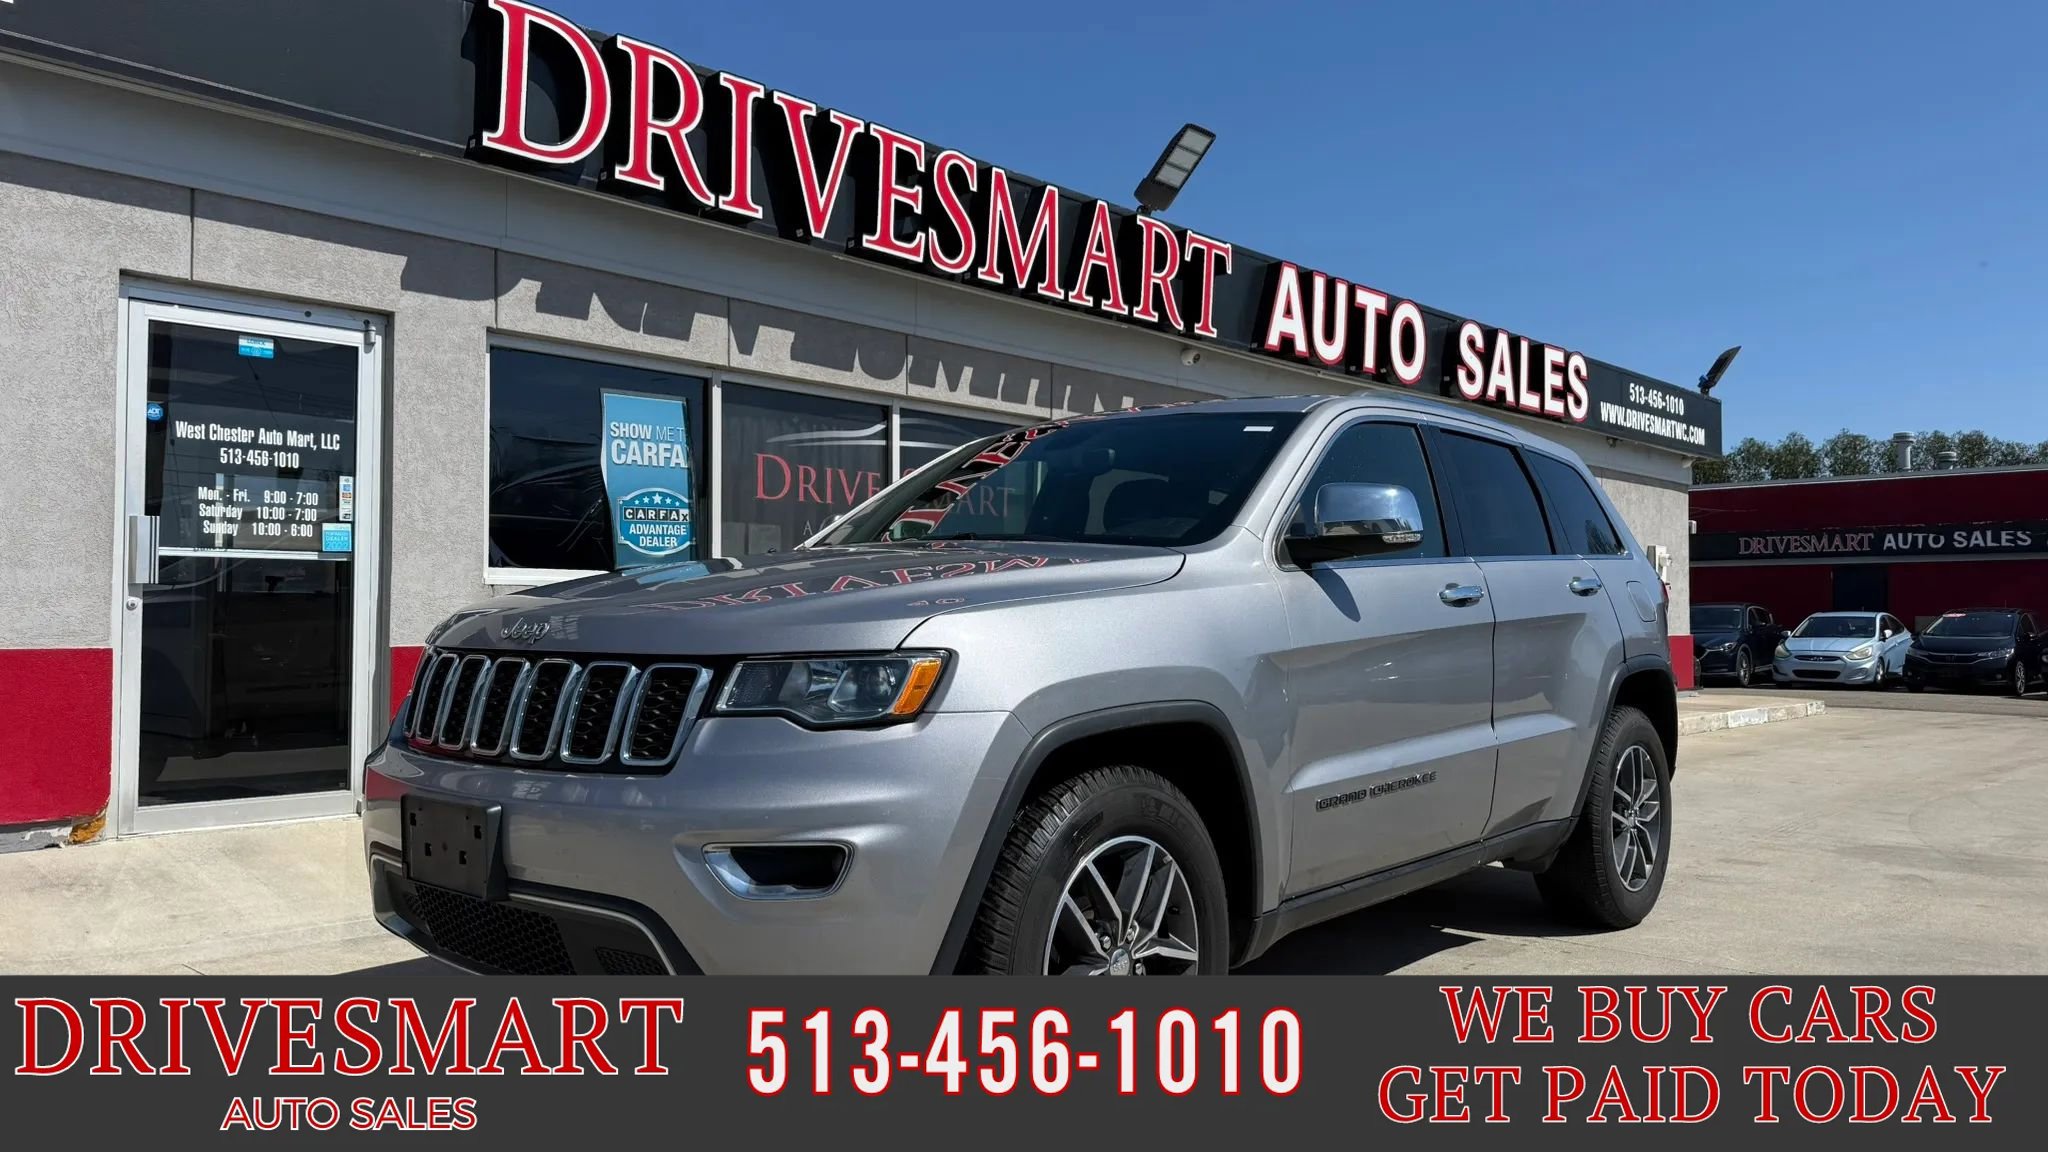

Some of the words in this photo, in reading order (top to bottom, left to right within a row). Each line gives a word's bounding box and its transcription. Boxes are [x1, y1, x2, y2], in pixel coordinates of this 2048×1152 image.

[482, 0, 1232, 338] DRIVESMART
[1264, 260, 1428, 386] AUTO
[1456, 320, 1589, 422] SALES
[1629, 382, 1684, 416] 513-456-1010
[610, 421, 652, 440] SHOW
[656, 425, 675, 441] ME
[1600, 401, 1705, 446] WWW.DRIVESMARTWC.COM
[175, 421, 206, 440] West
[209, 423, 255, 443] Chester
[258, 428, 283, 446] Auto
[286, 430, 317, 451] Mart,
[321, 433, 341, 450] LLC
[220, 447, 300, 468] 513-456-1010
[611, 438, 688, 468] CARFA
[198, 486, 223, 501] Mon.
[233, 488, 251, 502] Fri.
[264, 490, 287, 504] 9:00
[296, 492, 319, 506] 7:00
[199, 503, 243, 520] Saturday
[256, 506, 285, 520] 10:00
[295, 507, 317, 522] 7:00
[624, 508, 688, 521] CARFAX
[203, 520, 239, 536] Sunday
[252, 522, 281, 536] 10:00
[290, 524, 313, 538] 6:00
[629, 523, 687, 535] ADVANTAGE
[640, 535, 677, 547] DEALER
[1739, 532, 1874, 555] DRIVESMART
[1883, 533, 1945, 550] AUTO
[1953, 530, 2032, 547] SALES
[501, 617, 550, 644] Jeep
[1316, 789, 1367, 811] GRAND
[1369, 771, 1437, 799] CHEROKEE
